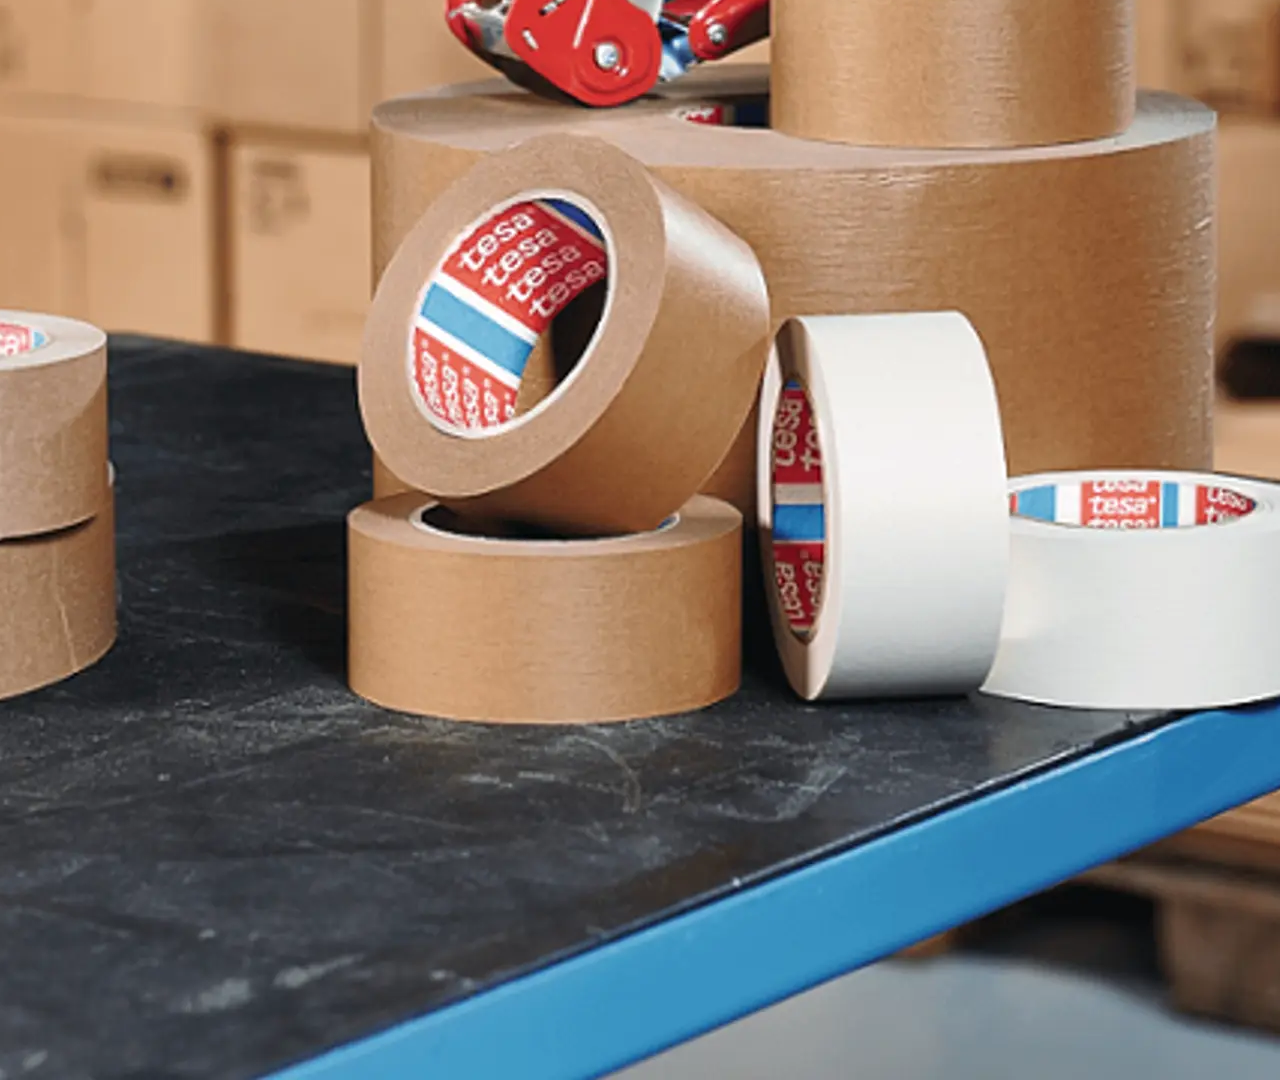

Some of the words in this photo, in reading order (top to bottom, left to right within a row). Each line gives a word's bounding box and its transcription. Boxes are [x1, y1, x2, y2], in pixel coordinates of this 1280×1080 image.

[457, 213, 535, 271] tesa
[481, 228, 559, 286] tesa
[505, 245, 582, 302] tesa
[528, 260, 604, 318] tesa
[1088, 496, 1148, 514] tesa
